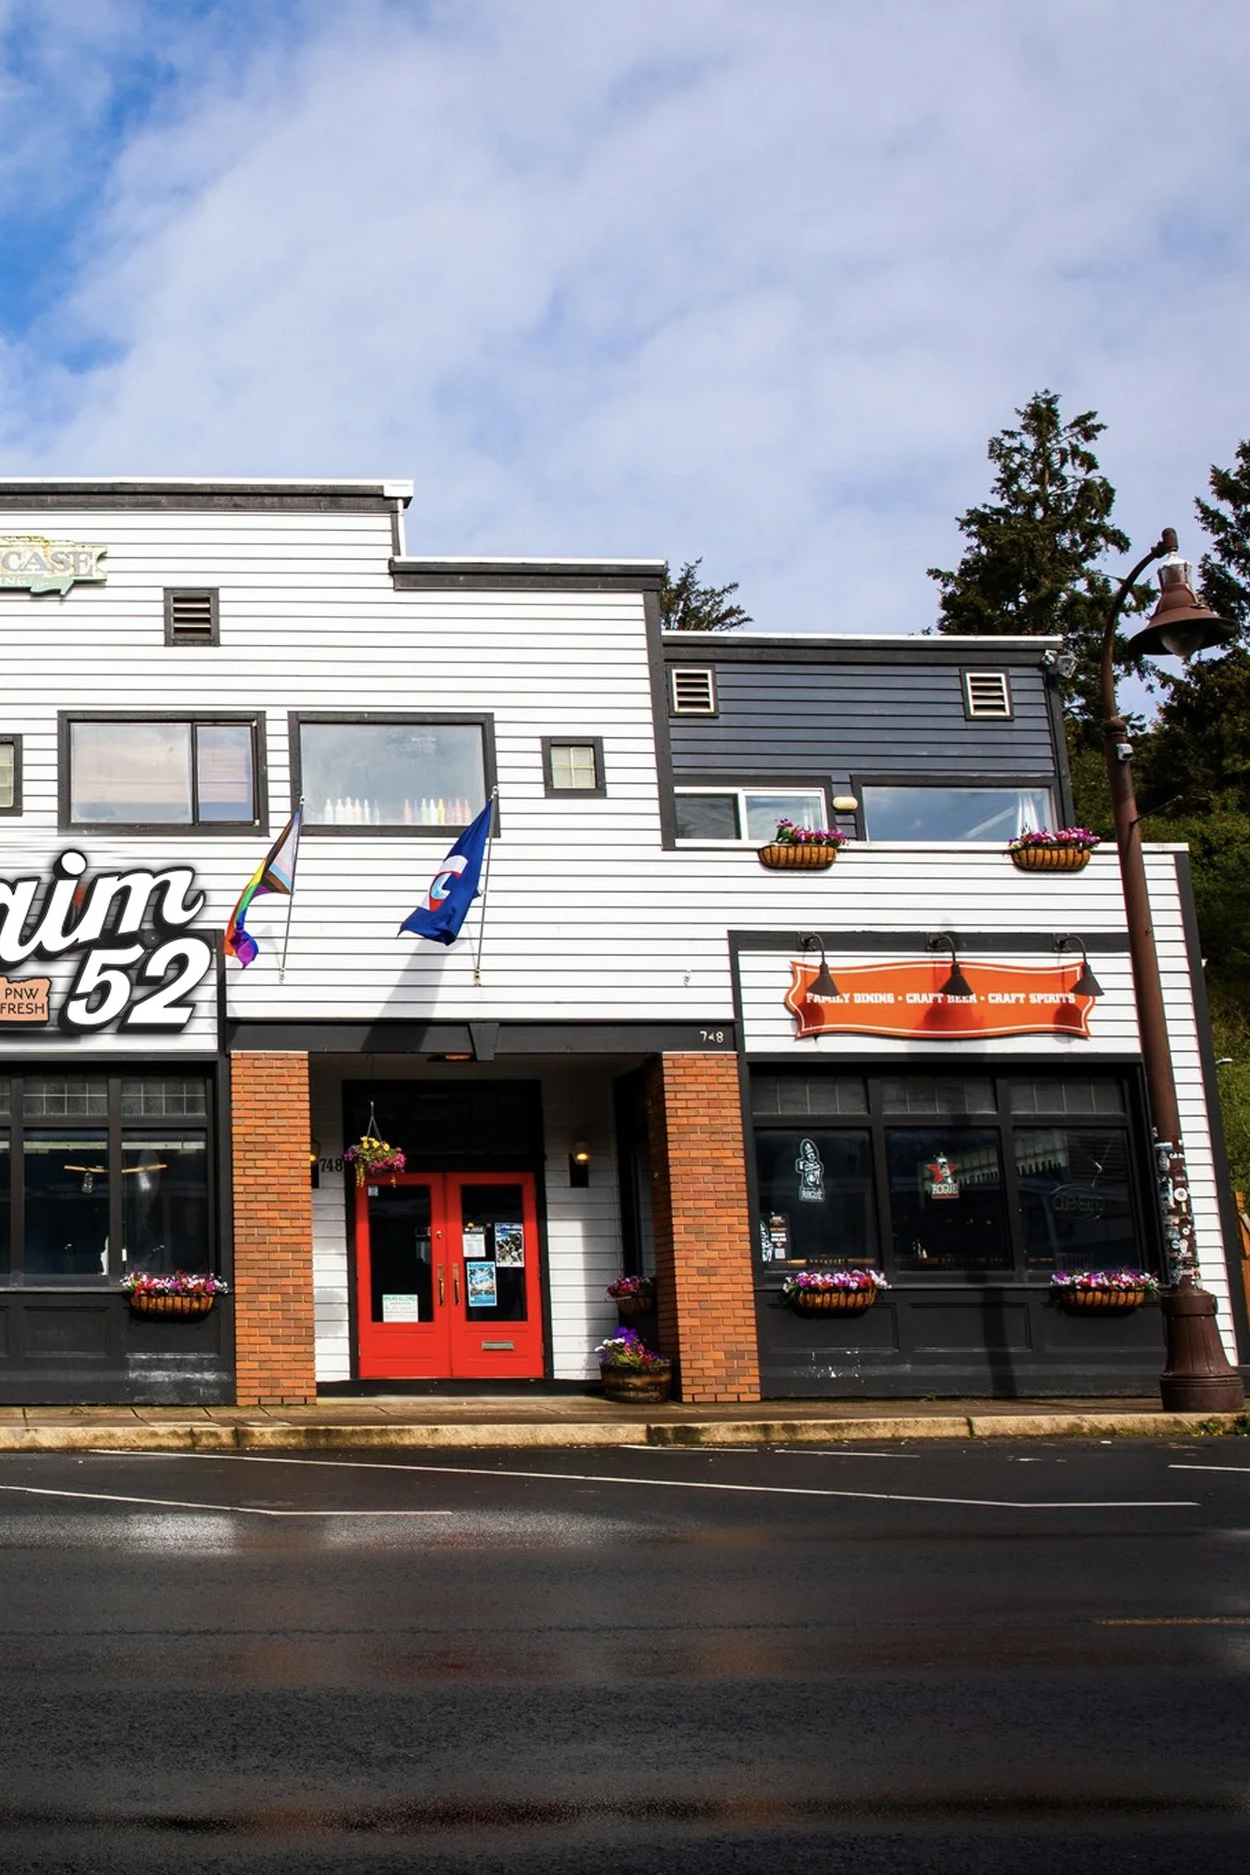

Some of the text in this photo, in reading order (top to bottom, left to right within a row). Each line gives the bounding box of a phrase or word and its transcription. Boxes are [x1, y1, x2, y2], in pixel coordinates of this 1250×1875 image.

[2, 551, 93, 577] CASE
[66, 936, 212, 1027] 52
[5, 987, 39, 999] PNW
[806, 992, 1076, 1004] FAMILY DINING CRAFT BEER CRAFT SPIRITS
[0, 1002, 45, 1015] FRESH
[700, 1030, 724, 1043] 748
[320, 1157, 343, 1172] 748
